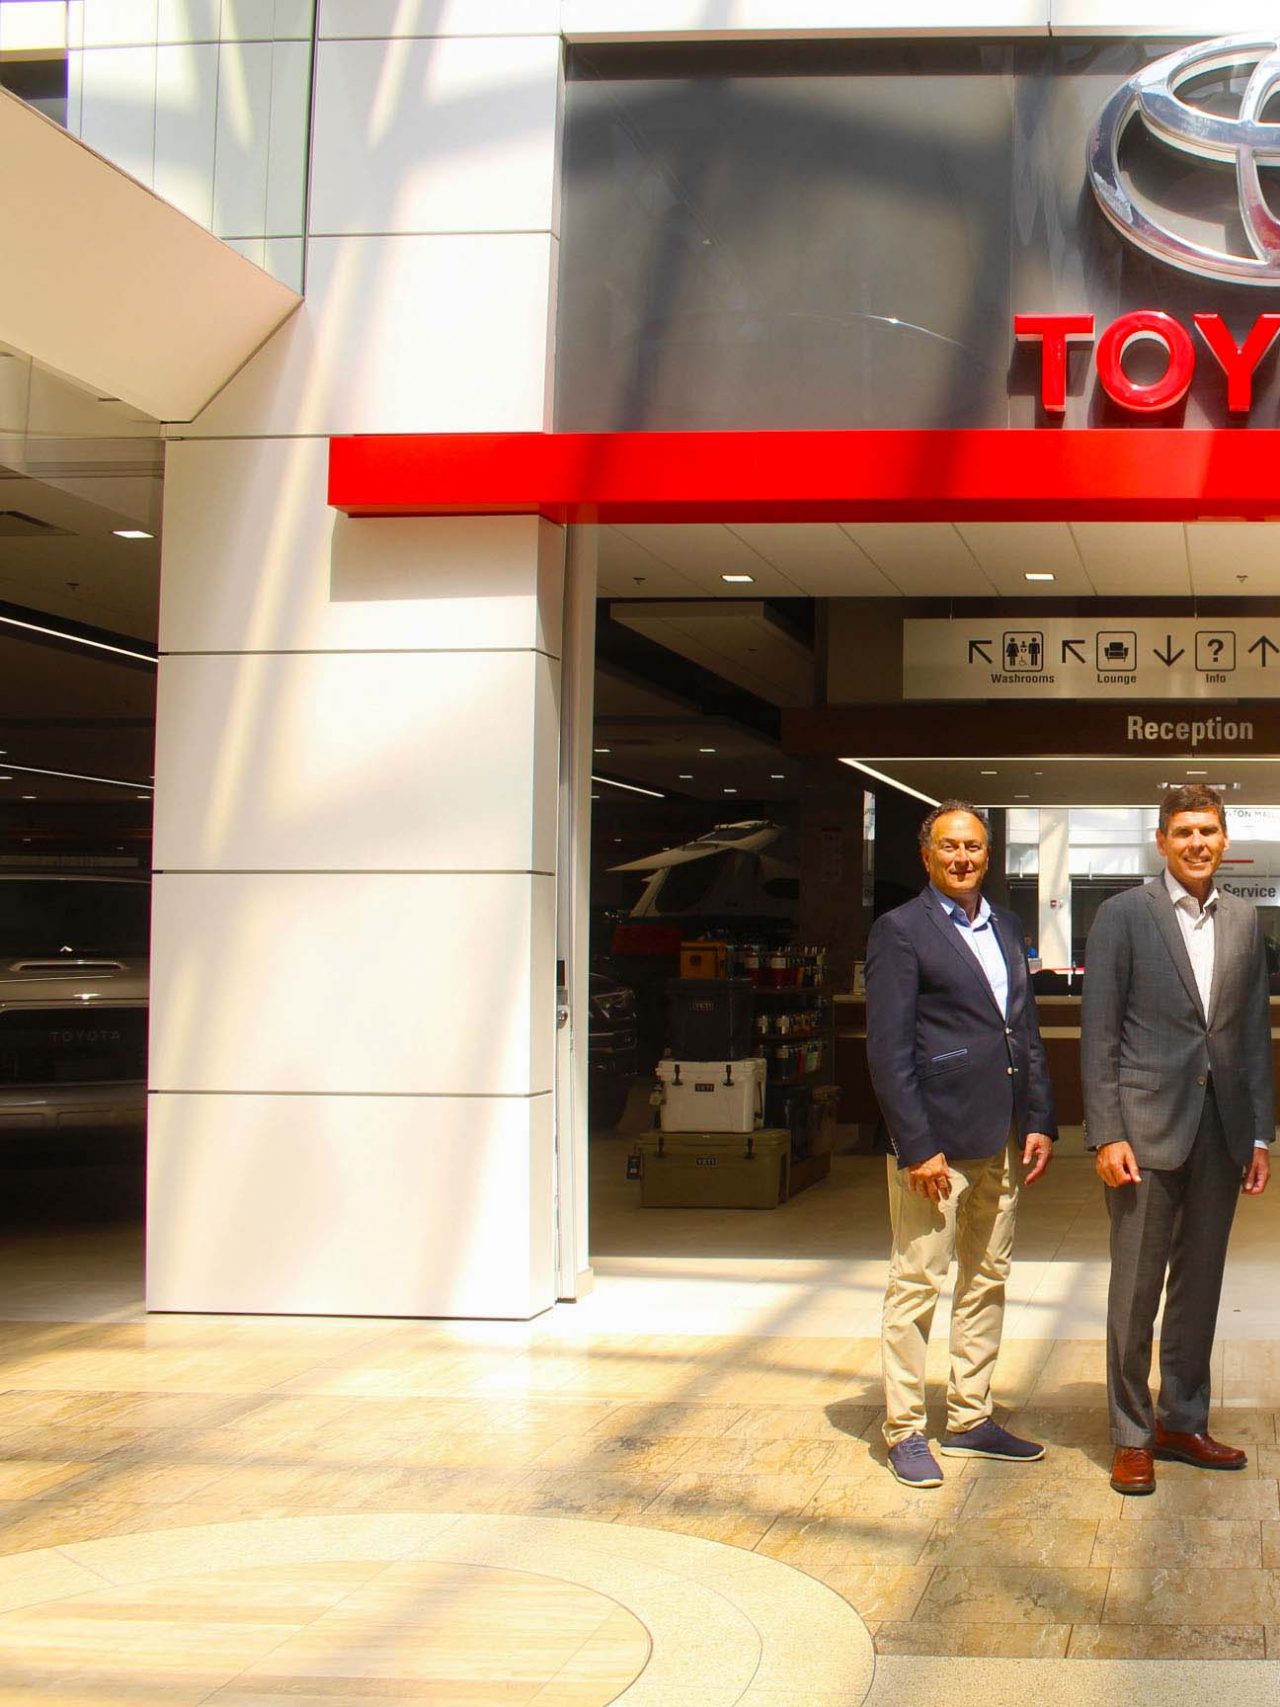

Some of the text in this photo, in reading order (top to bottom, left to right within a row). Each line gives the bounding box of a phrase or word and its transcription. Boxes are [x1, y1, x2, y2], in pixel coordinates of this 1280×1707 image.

[991, 673, 1055, 684] Washrooms
[1097, 673, 1137, 685] Lounge
[1206, 673, 1227, 684] Info
[1127, 715, 1254, 746] Reception
[1223, 883, 1277, 898] Service
[50, 1029, 121, 1042] TOYOTA
